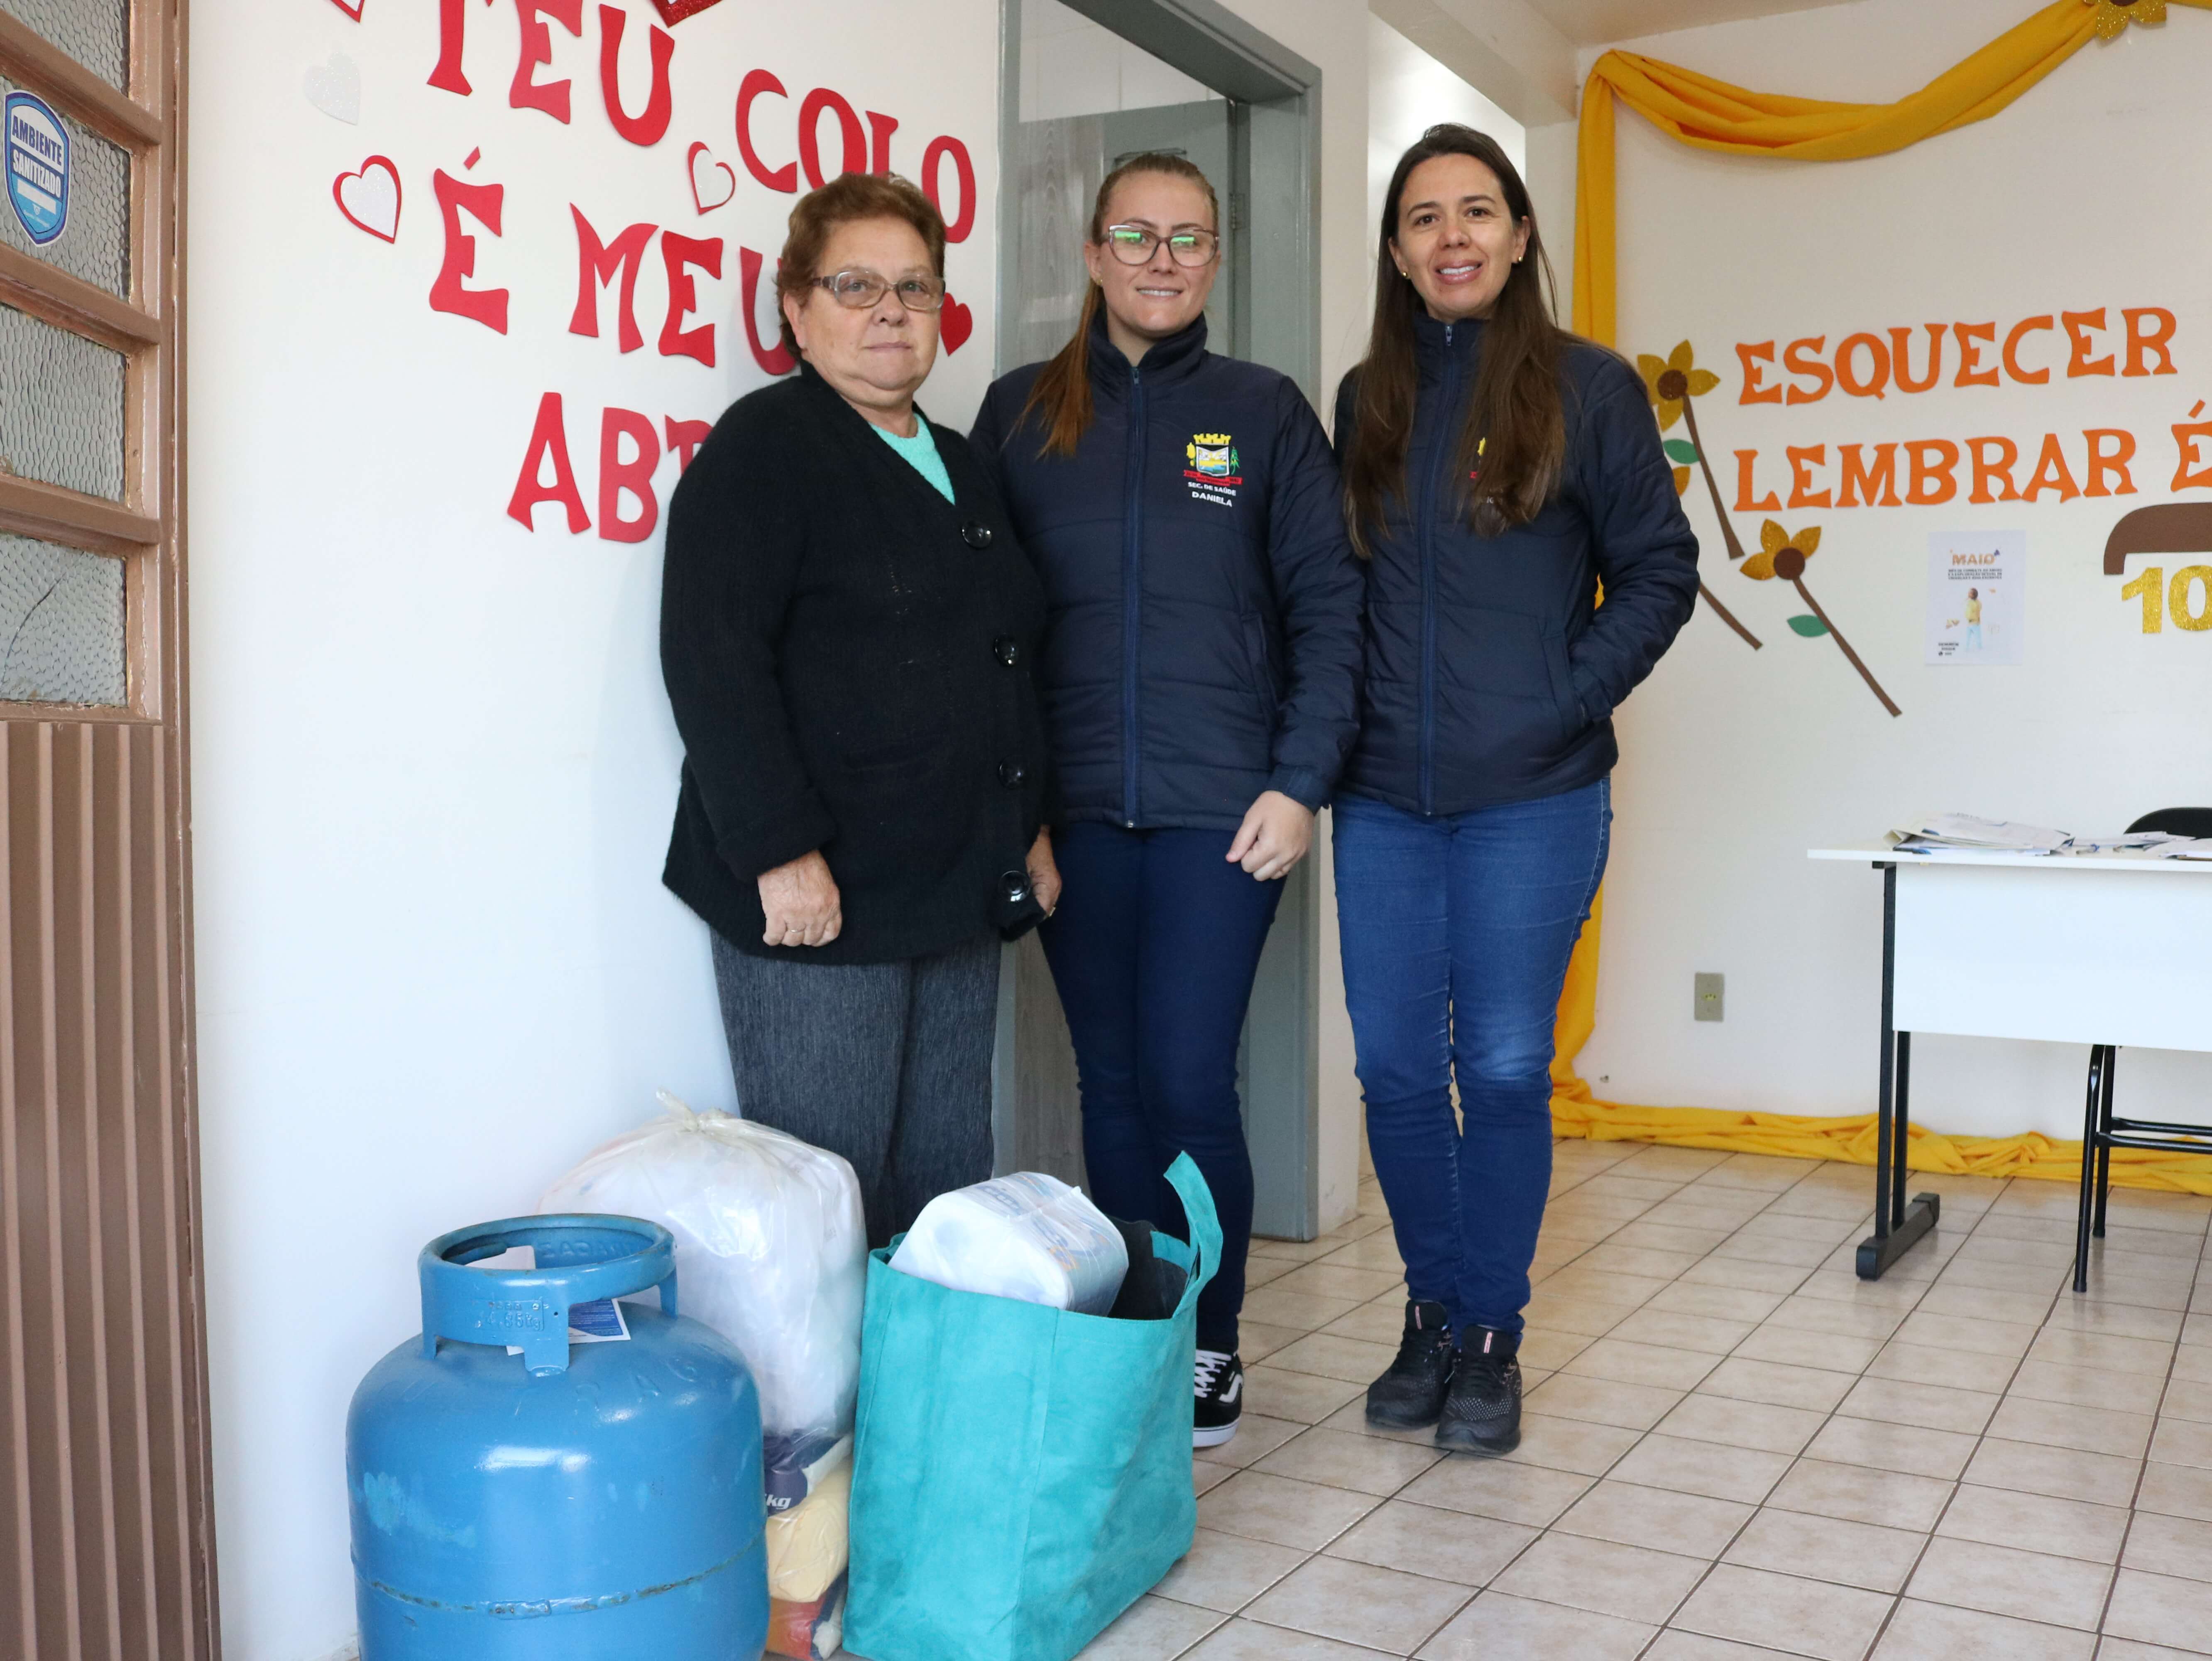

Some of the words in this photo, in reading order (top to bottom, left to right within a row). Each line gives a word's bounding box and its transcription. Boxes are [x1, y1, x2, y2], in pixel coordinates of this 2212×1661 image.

[427, 0, 675, 147] TEU
[12, 115, 62, 165] AMBIENTE
[13, 149, 61, 198] SANITIZADO
[429, 146, 509, 335] É
[568, 203, 797, 376] MEU
[1735, 307, 2178, 406] ESQUECER
[1214, 486, 1236, 496] SAÚDE
[1733, 428, 2139, 512] LEMBRAR
[1192, 491, 1233, 507] DANIELA
[1953, 554, 1996, 565] MAIO
[765, 1494, 792, 1510] kg
